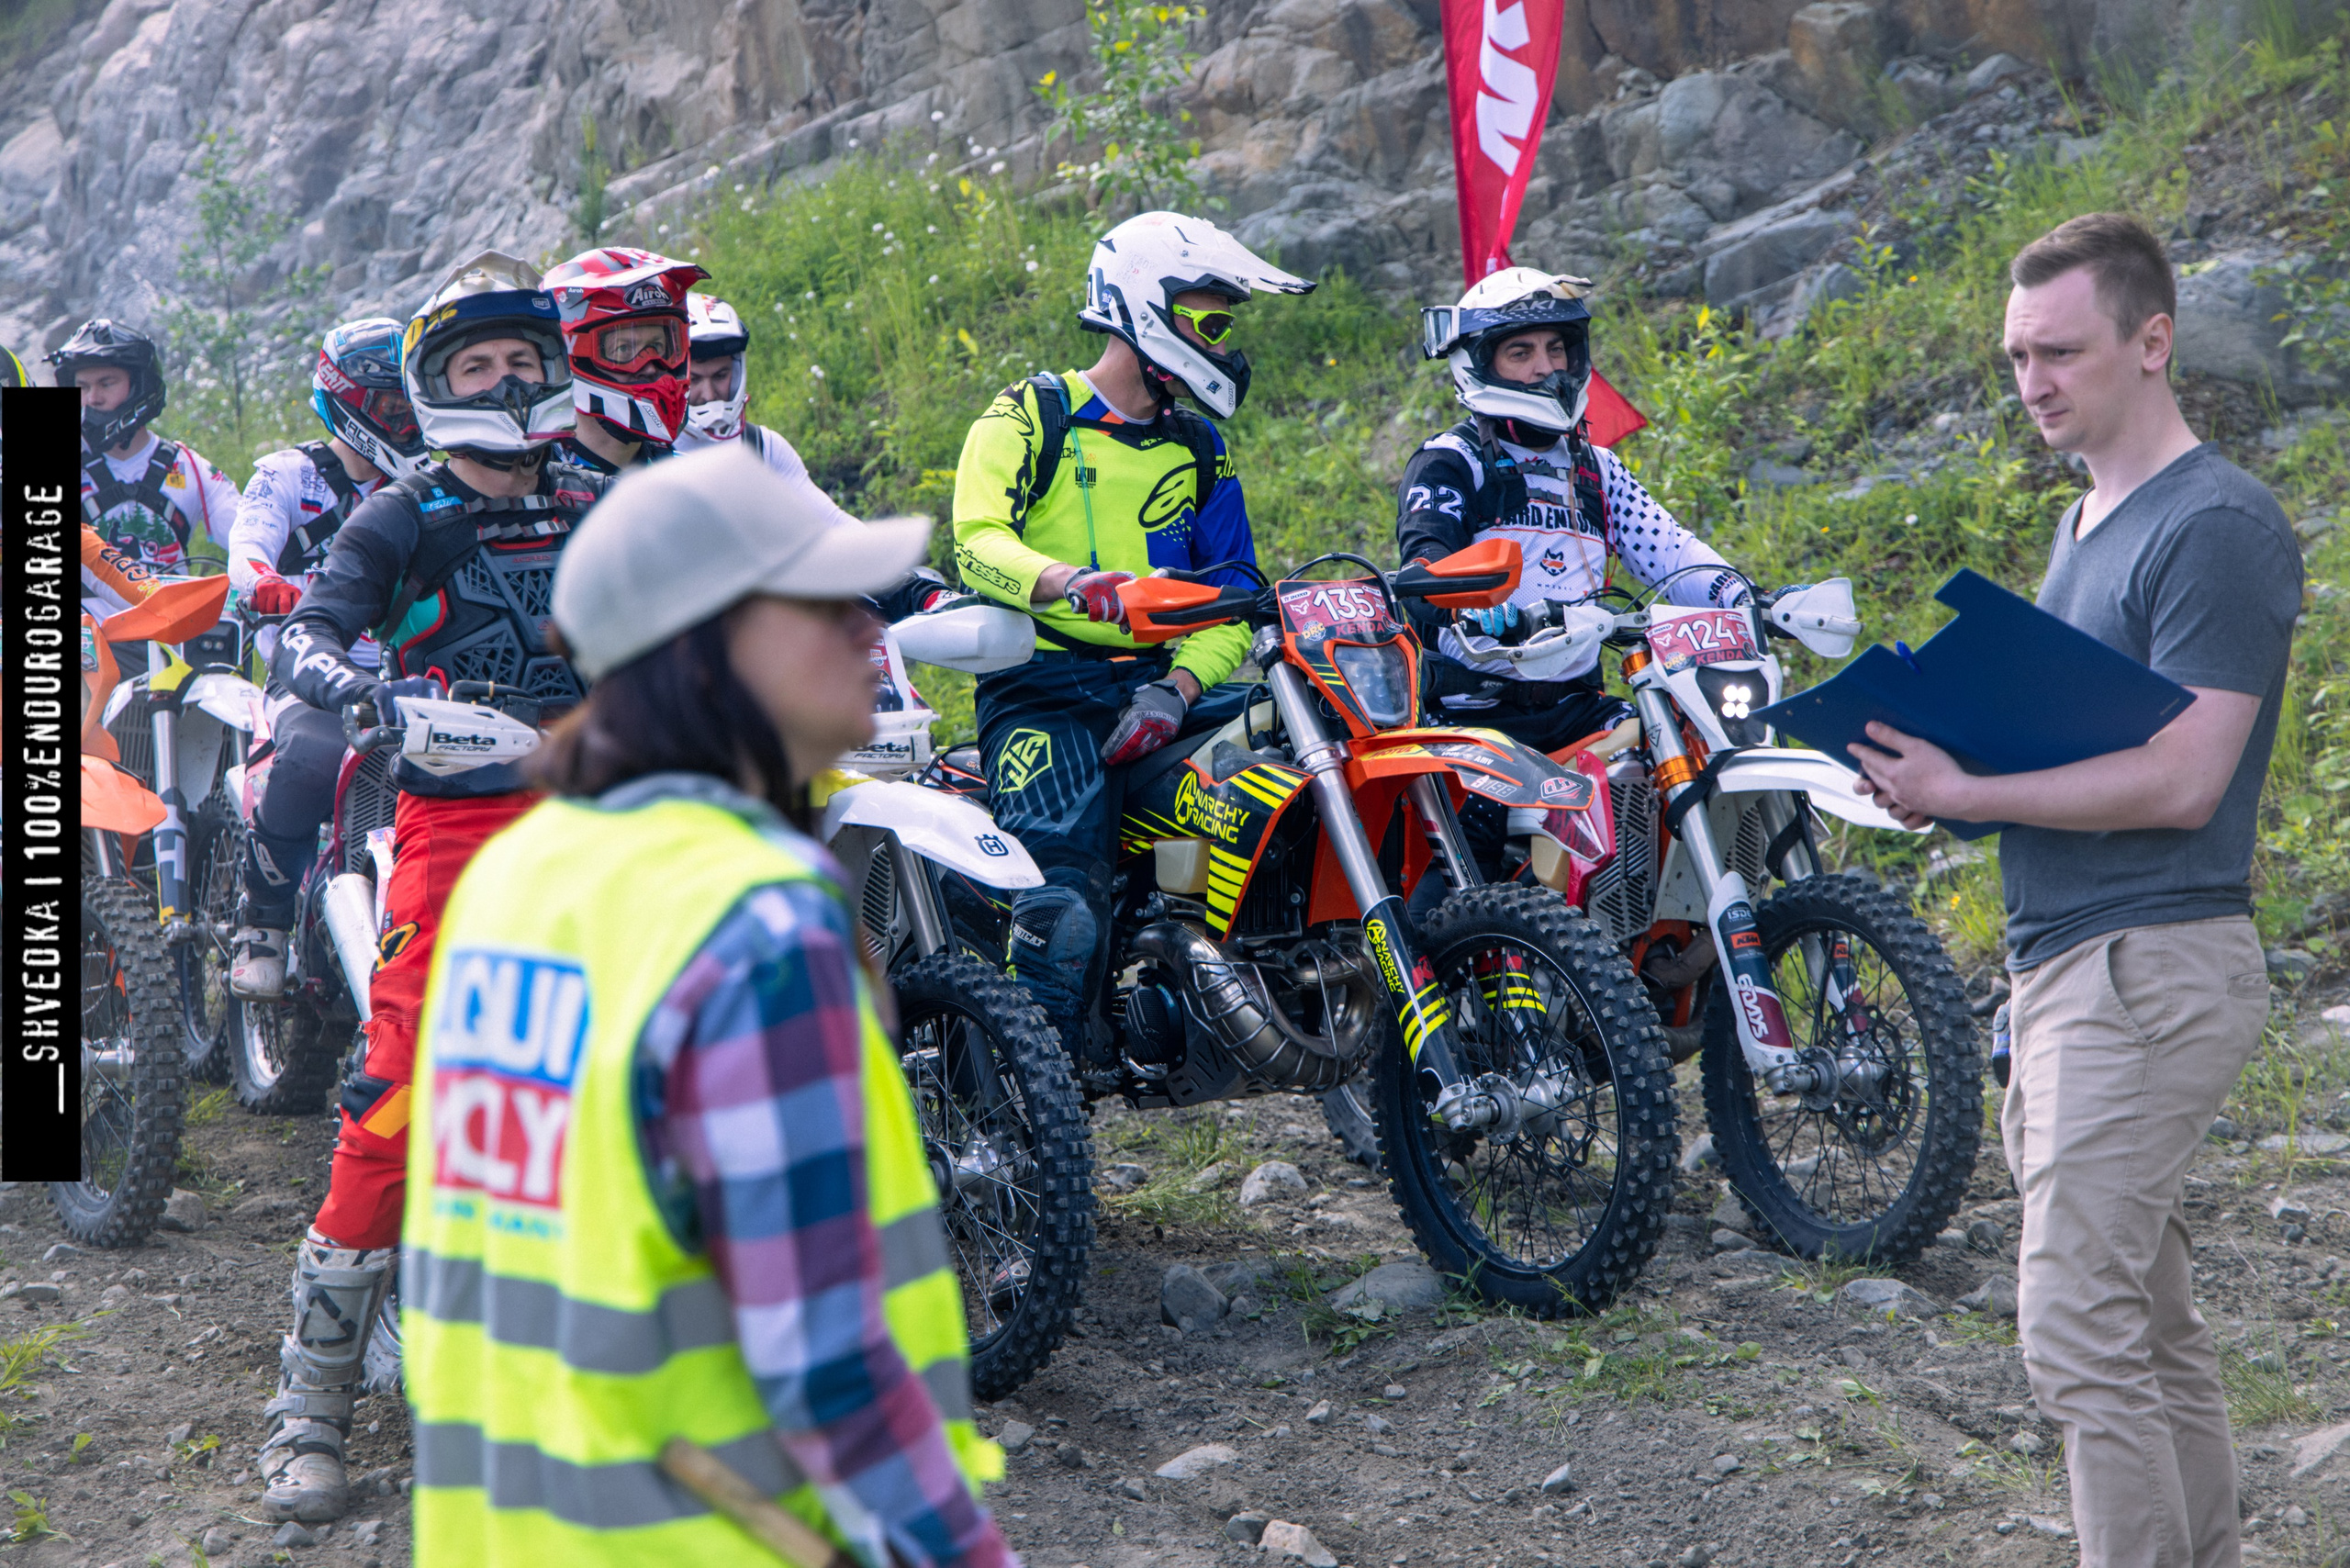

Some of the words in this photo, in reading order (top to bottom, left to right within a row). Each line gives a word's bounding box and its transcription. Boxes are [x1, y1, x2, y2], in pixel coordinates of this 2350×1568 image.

[631, 286, 670, 305] Airoh
[318, 357, 355, 394] LEATT
[1406, 484, 1466, 522] 22
[1312, 588, 1376, 622] 135
[1302, 623, 1326, 640] DRC
[1336, 622, 1386, 637] KENDA
[1675, 616, 1739, 652] 124
[1695, 649, 1745, 666] KENDA
[431, 734, 497, 745] Beta
[1189, 806, 1239, 845] RACING
[1736, 935, 1759, 946] KTM
